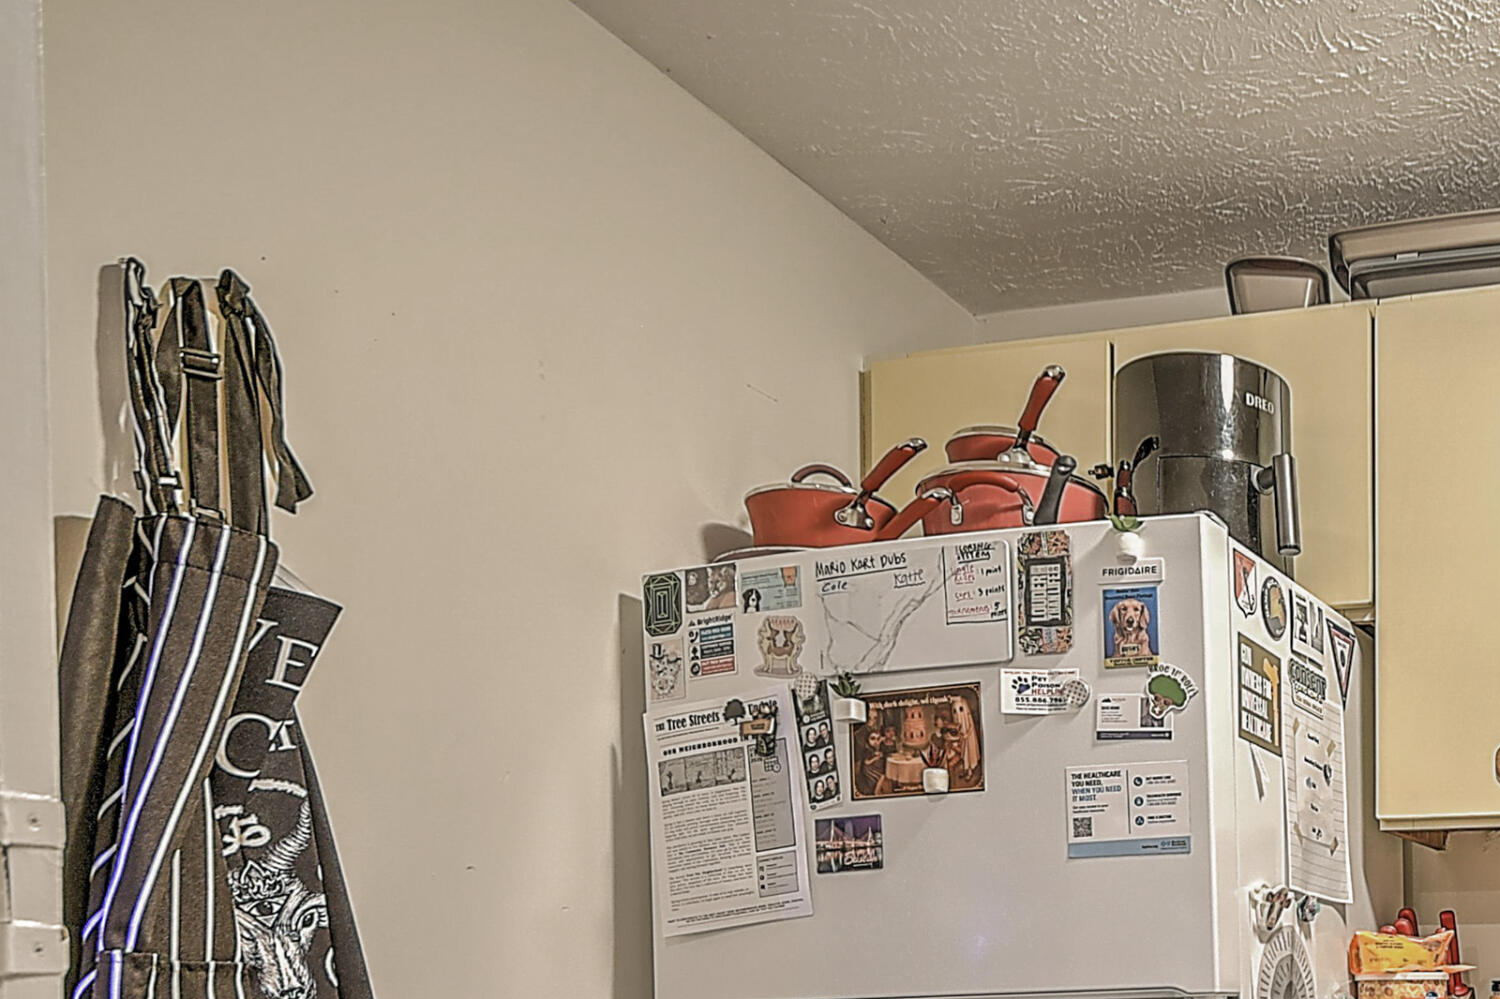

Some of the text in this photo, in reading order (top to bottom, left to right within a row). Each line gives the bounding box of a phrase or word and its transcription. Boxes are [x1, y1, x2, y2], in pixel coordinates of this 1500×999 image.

[1245, 392, 1276, 415] DREO
[1102, 565, 1158, 577] FRIGIDAIRE
[821, 581, 848, 593] Cole
[1030, 575, 1047, 622] LOUDER
[666, 718, 688, 731] Tree
[689, 711, 720, 727] Streets
[679, 737, 738, 752] NEIGHBORHOOD
[1083, 770, 1121, 779] HEALTHCARE
[1072, 785, 1121, 795] WHEN YOU NEED
